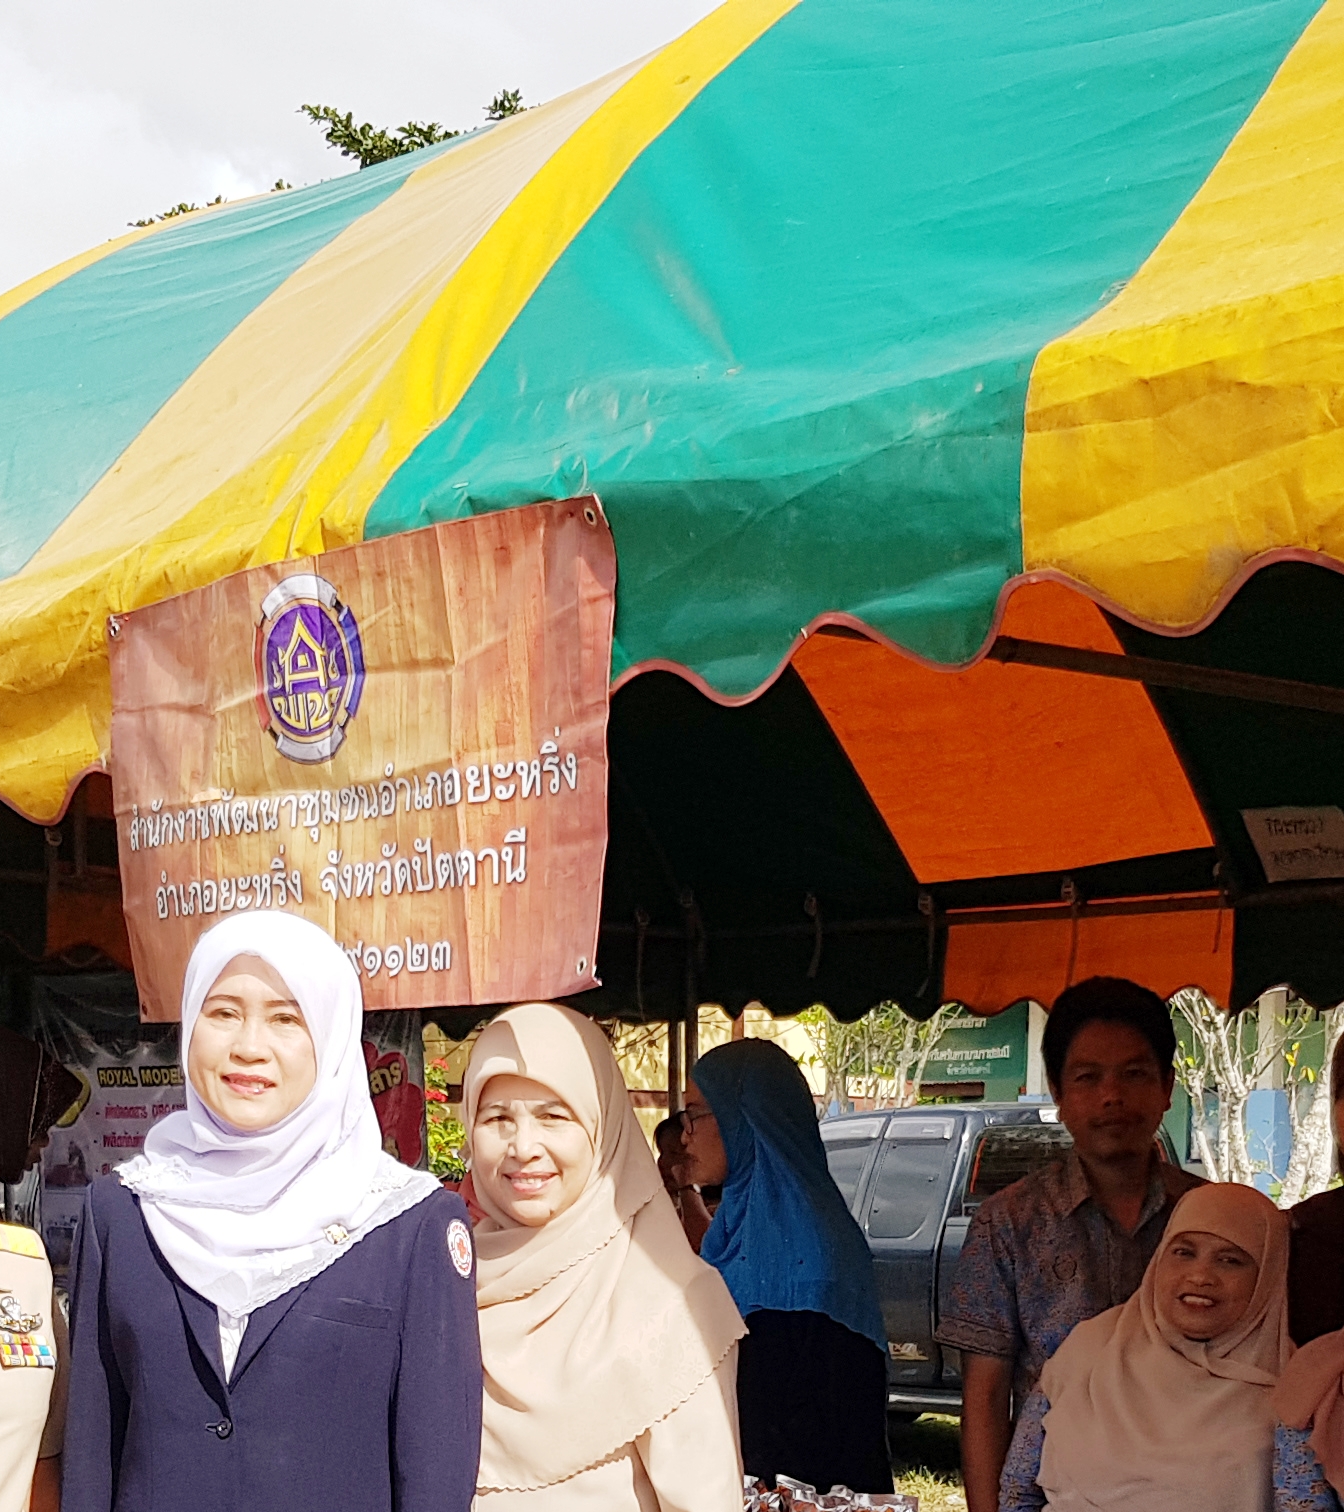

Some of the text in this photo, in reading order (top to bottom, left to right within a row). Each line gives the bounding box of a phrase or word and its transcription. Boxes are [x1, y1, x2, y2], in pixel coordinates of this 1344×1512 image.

[157, 825, 526, 919] อำเภอยะหริ่ง จังหวัดปัตตานี
[98, 1065, 183, 1087] ROYAL MODEL
